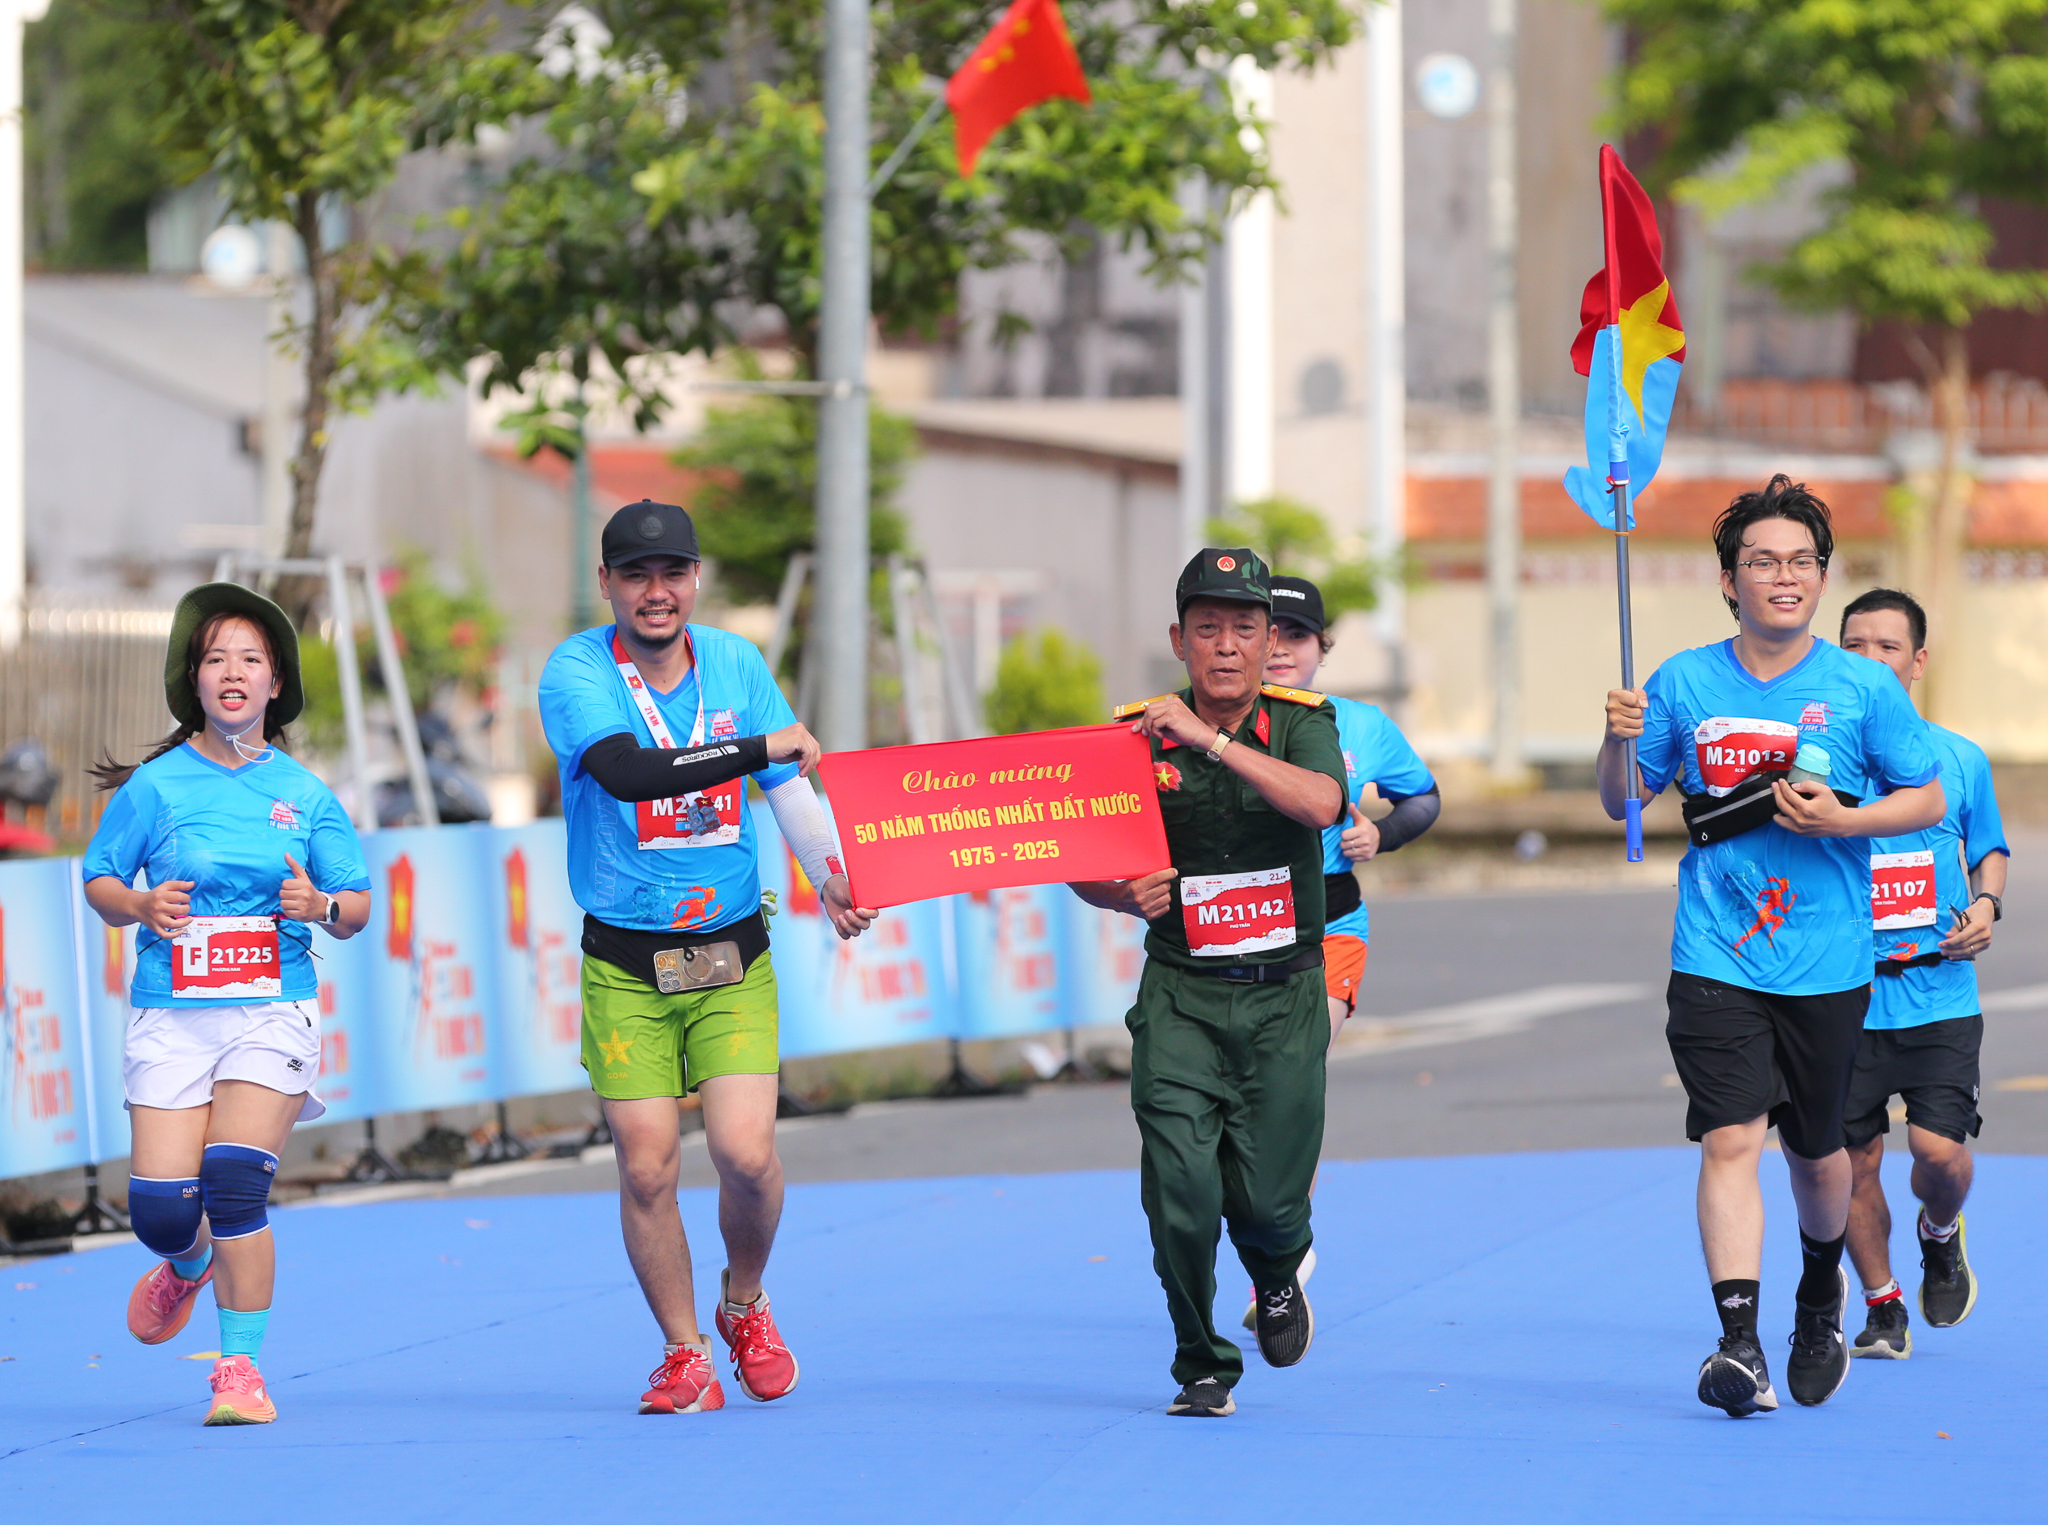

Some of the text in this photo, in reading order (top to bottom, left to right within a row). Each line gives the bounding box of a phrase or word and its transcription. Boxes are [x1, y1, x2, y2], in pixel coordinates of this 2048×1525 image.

[644, 705, 660, 727] 21 KM
[1705, 745, 1786, 766] M21012
[902, 763, 1075, 793] Chào mừng
[651, 793, 732, 817] M241
[854, 823, 878, 844] 50
[880, 814, 925, 840] NĂM
[927, 804, 992, 833] THỐNG
[995, 796, 1046, 826] NHẤT
[1049, 792, 1085, 821] ĐẤT
[1090, 791, 1142, 816] NƯỚC
[949, 845, 996, 868] 1975
[1013, 839, 1060, 861] 2025
[1198, 899, 1285, 925] M21142
[190, 947, 273, 965] F 21225
[219, 1360, 236, 1368] HOKA
